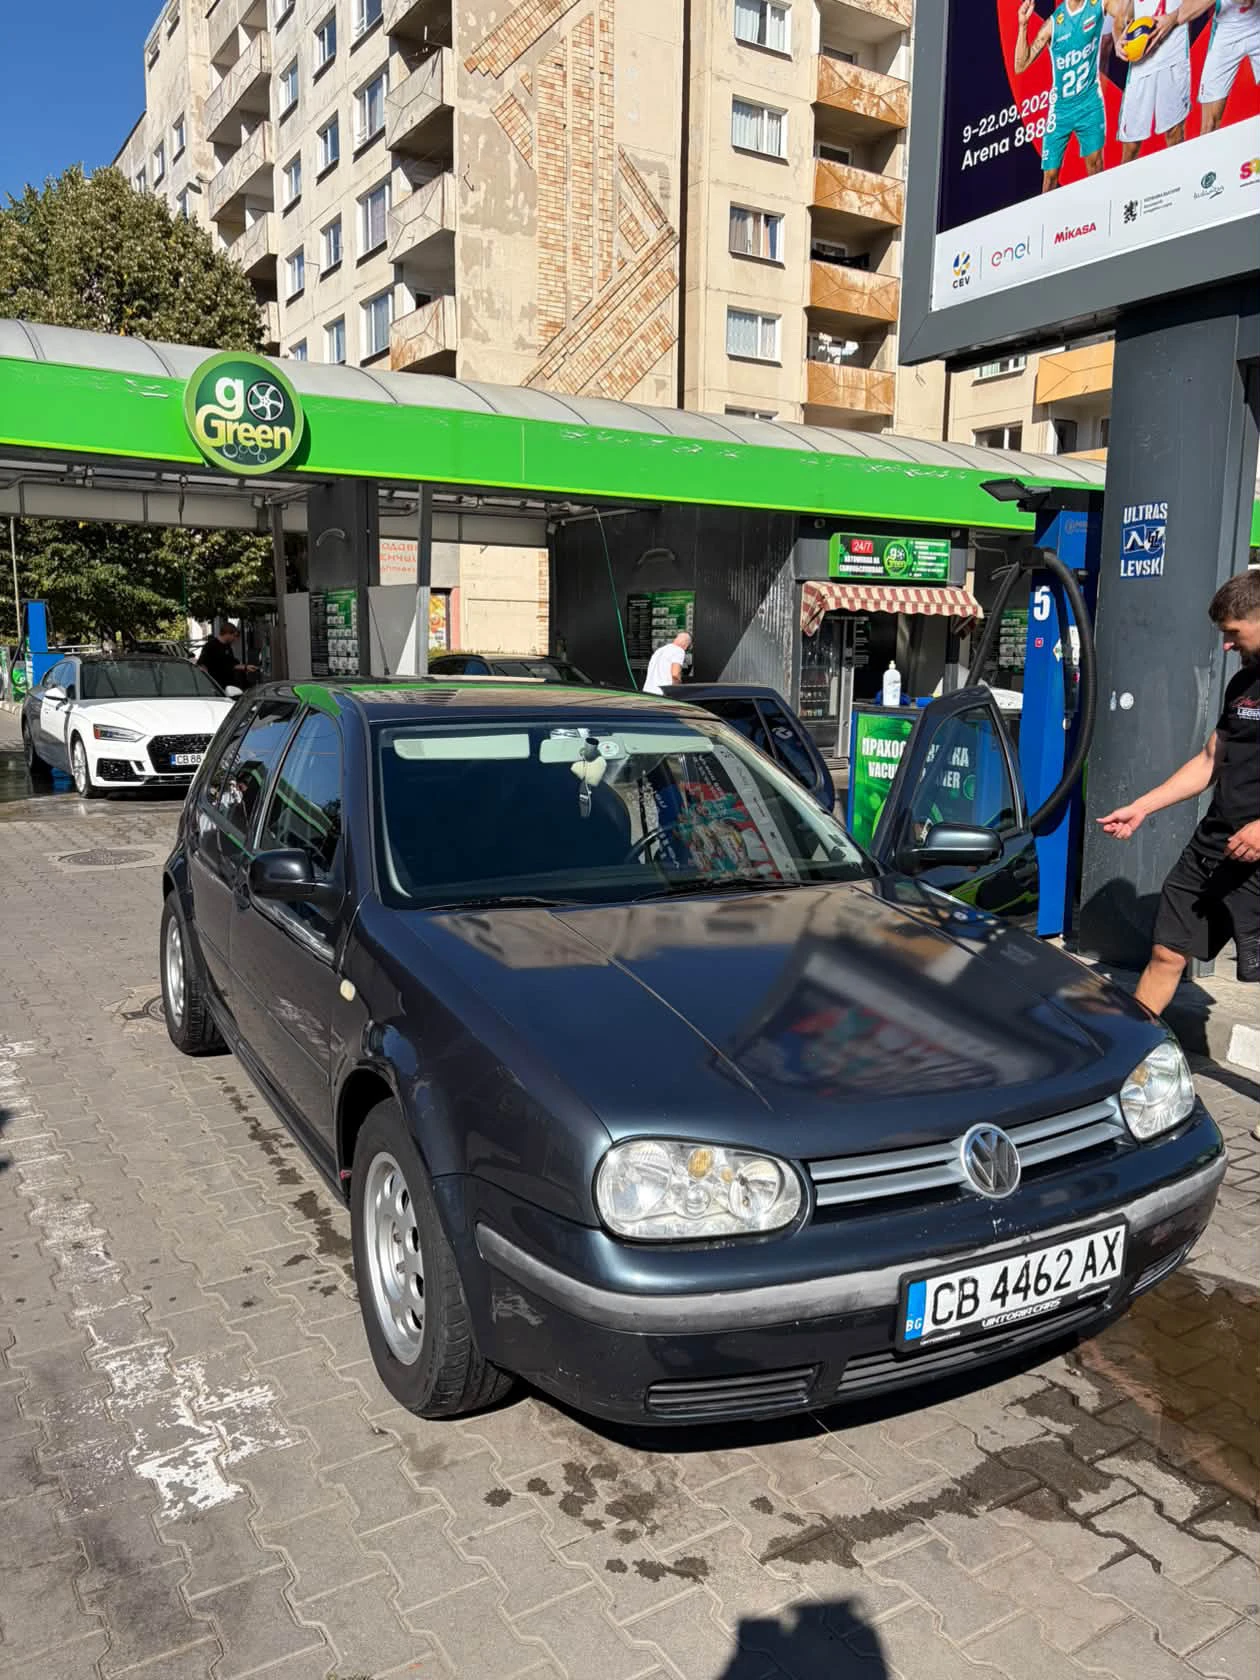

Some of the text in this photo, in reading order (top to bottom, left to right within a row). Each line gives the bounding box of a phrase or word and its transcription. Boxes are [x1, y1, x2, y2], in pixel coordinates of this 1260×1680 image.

[1062, 60, 1089, 98] 22
[961, 112, 1057, 171] Arena 8888
[991, 236, 1030, 267] enel
[952, 276, 971, 289] CEV
[195, 403, 293, 450] Green
[1123, 502, 1169, 525] ULTRAS
[854, 541, 872, 552] 24/7
[1120, 557, 1165, 577] LEVSKI
[1033, 585, 1051, 621] 5
[931, 1231, 1121, 1326] CB 4462 AX
[905, 1316, 922, 1333] BG
